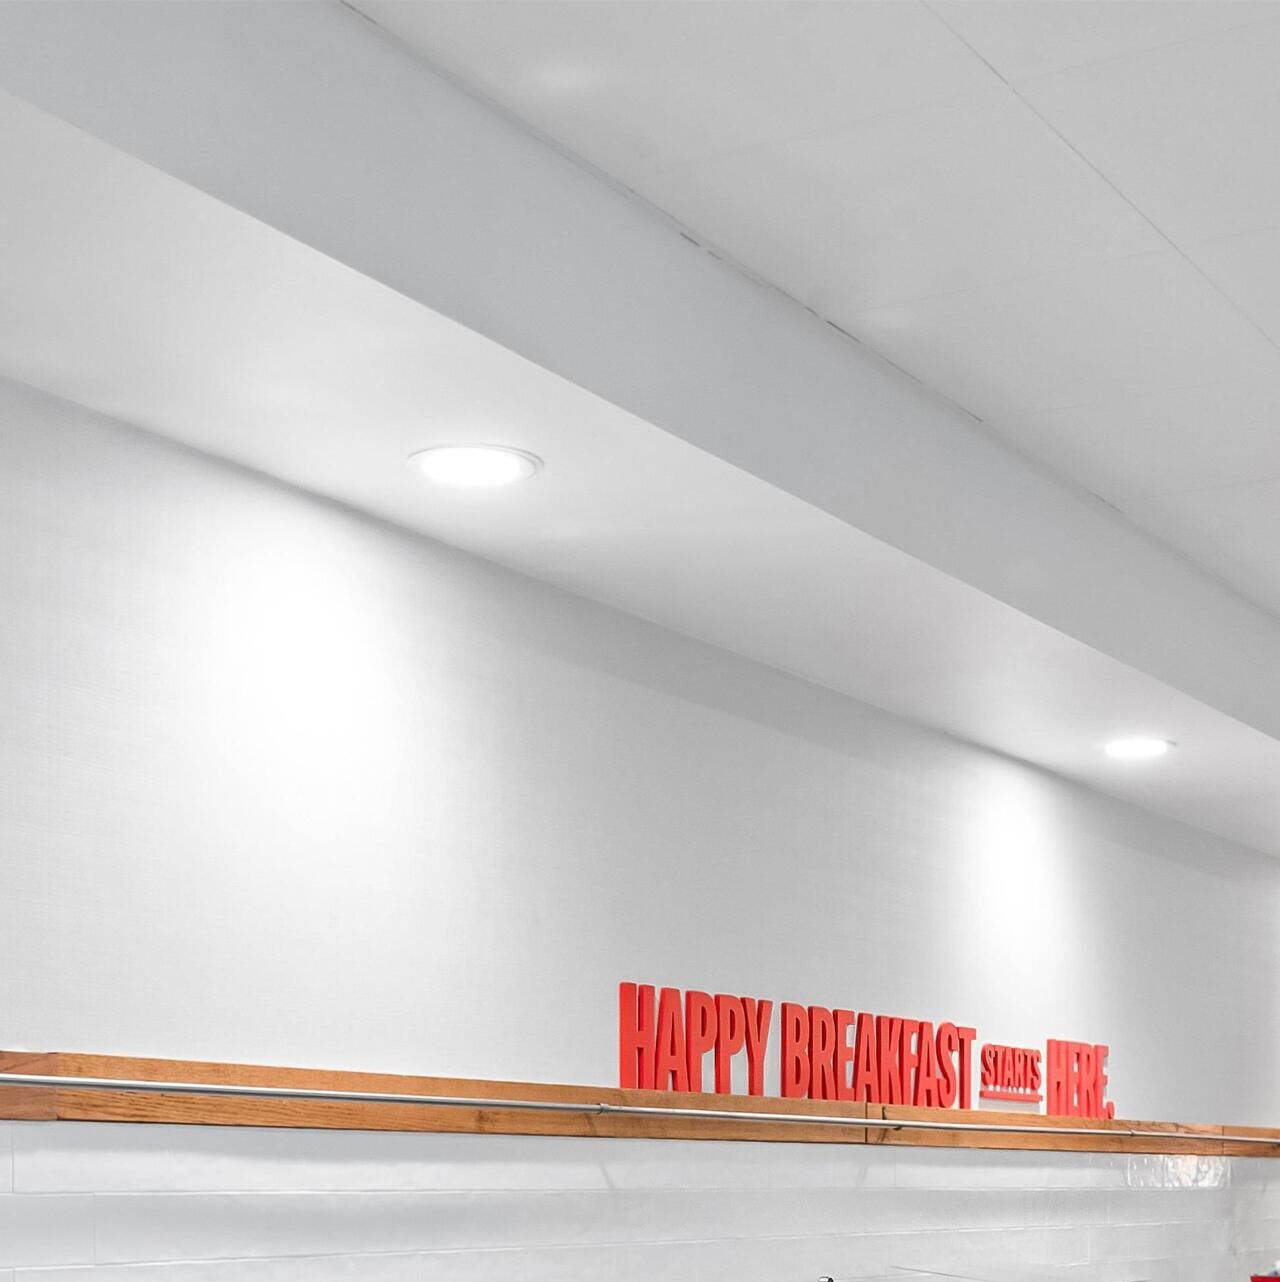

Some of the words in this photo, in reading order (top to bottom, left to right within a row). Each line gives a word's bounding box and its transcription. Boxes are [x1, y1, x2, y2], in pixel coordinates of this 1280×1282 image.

[619, 981, 773, 1097] HAPPY
[780, 1002, 977, 1110] BREAKFAST
[980, 1043, 1042, 1094] STARTS
[1046, 1038, 1115, 1120] HERE.
